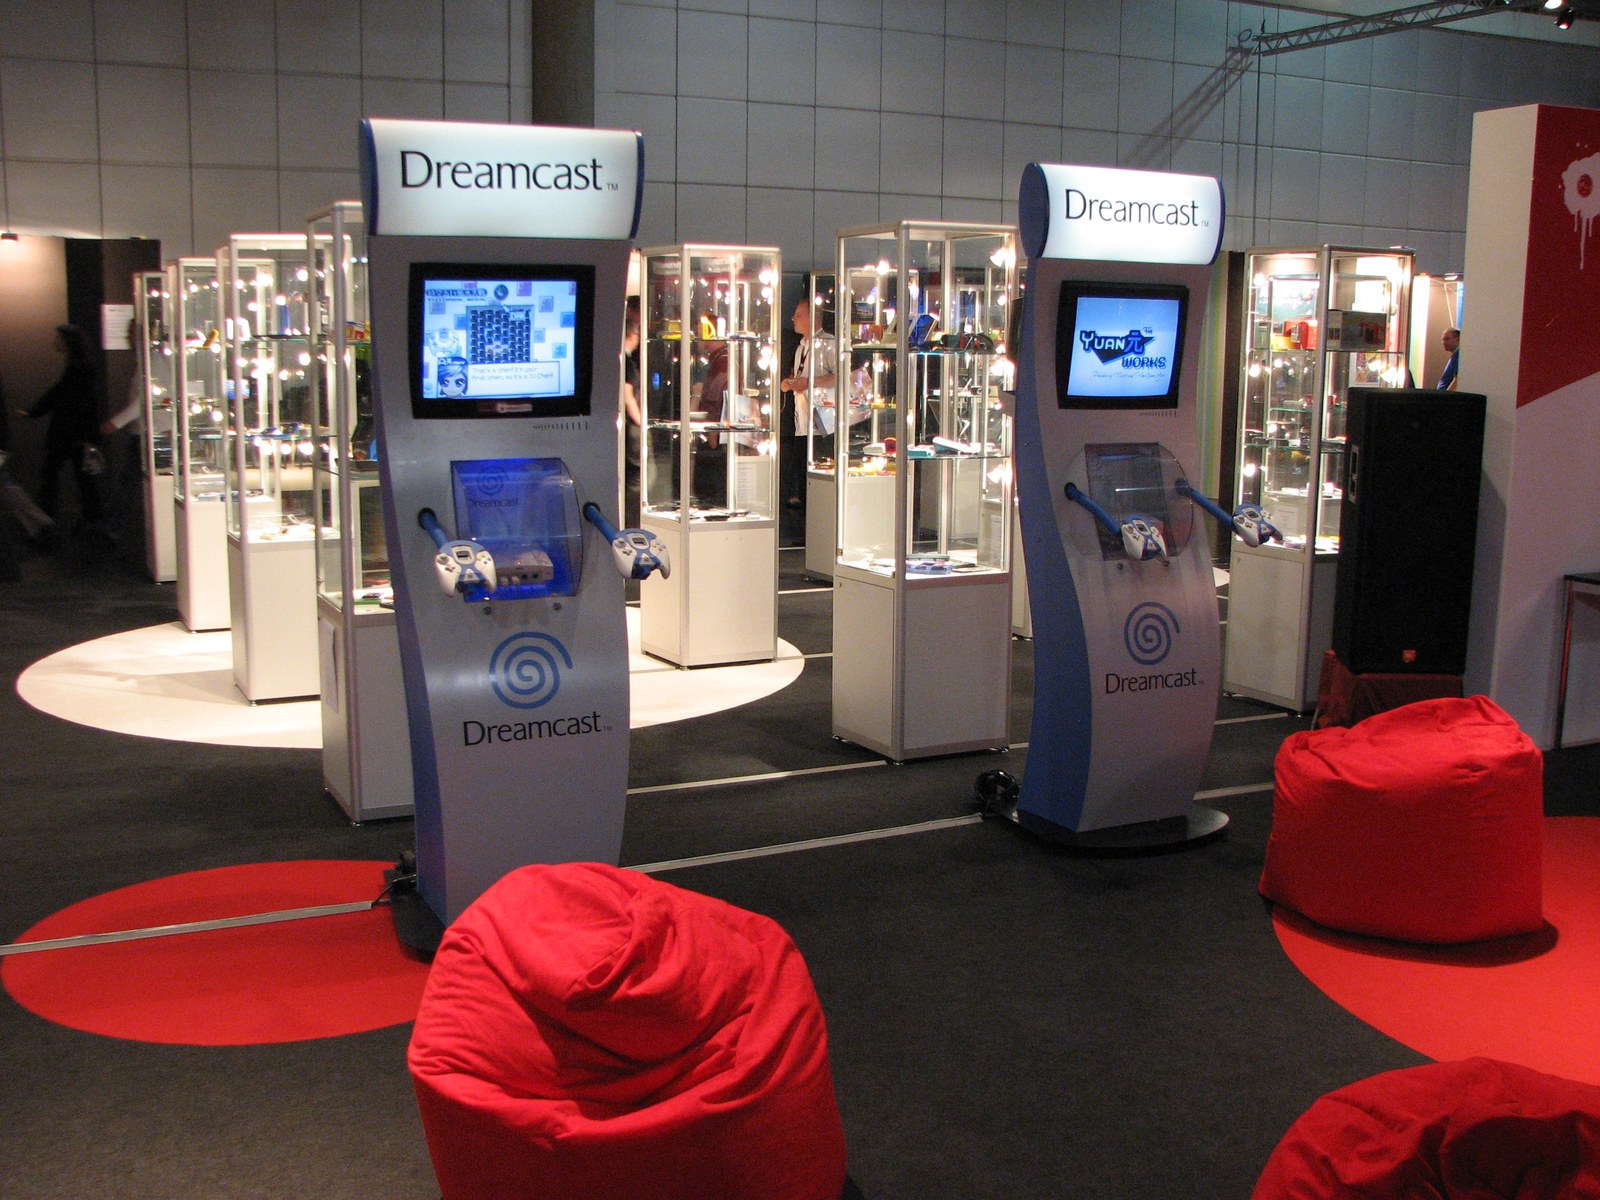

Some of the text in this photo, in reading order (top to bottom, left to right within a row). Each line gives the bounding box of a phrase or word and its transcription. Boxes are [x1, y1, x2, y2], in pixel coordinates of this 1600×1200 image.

[400, 150, 604, 192] Dreamcast
[1064, 188, 1199, 227] Dreamcast
[1121, 357, 1167, 369] WORKS
[1105, 667, 1197, 694] Dreamcast
[462, 711, 602, 747] Dreamcast
